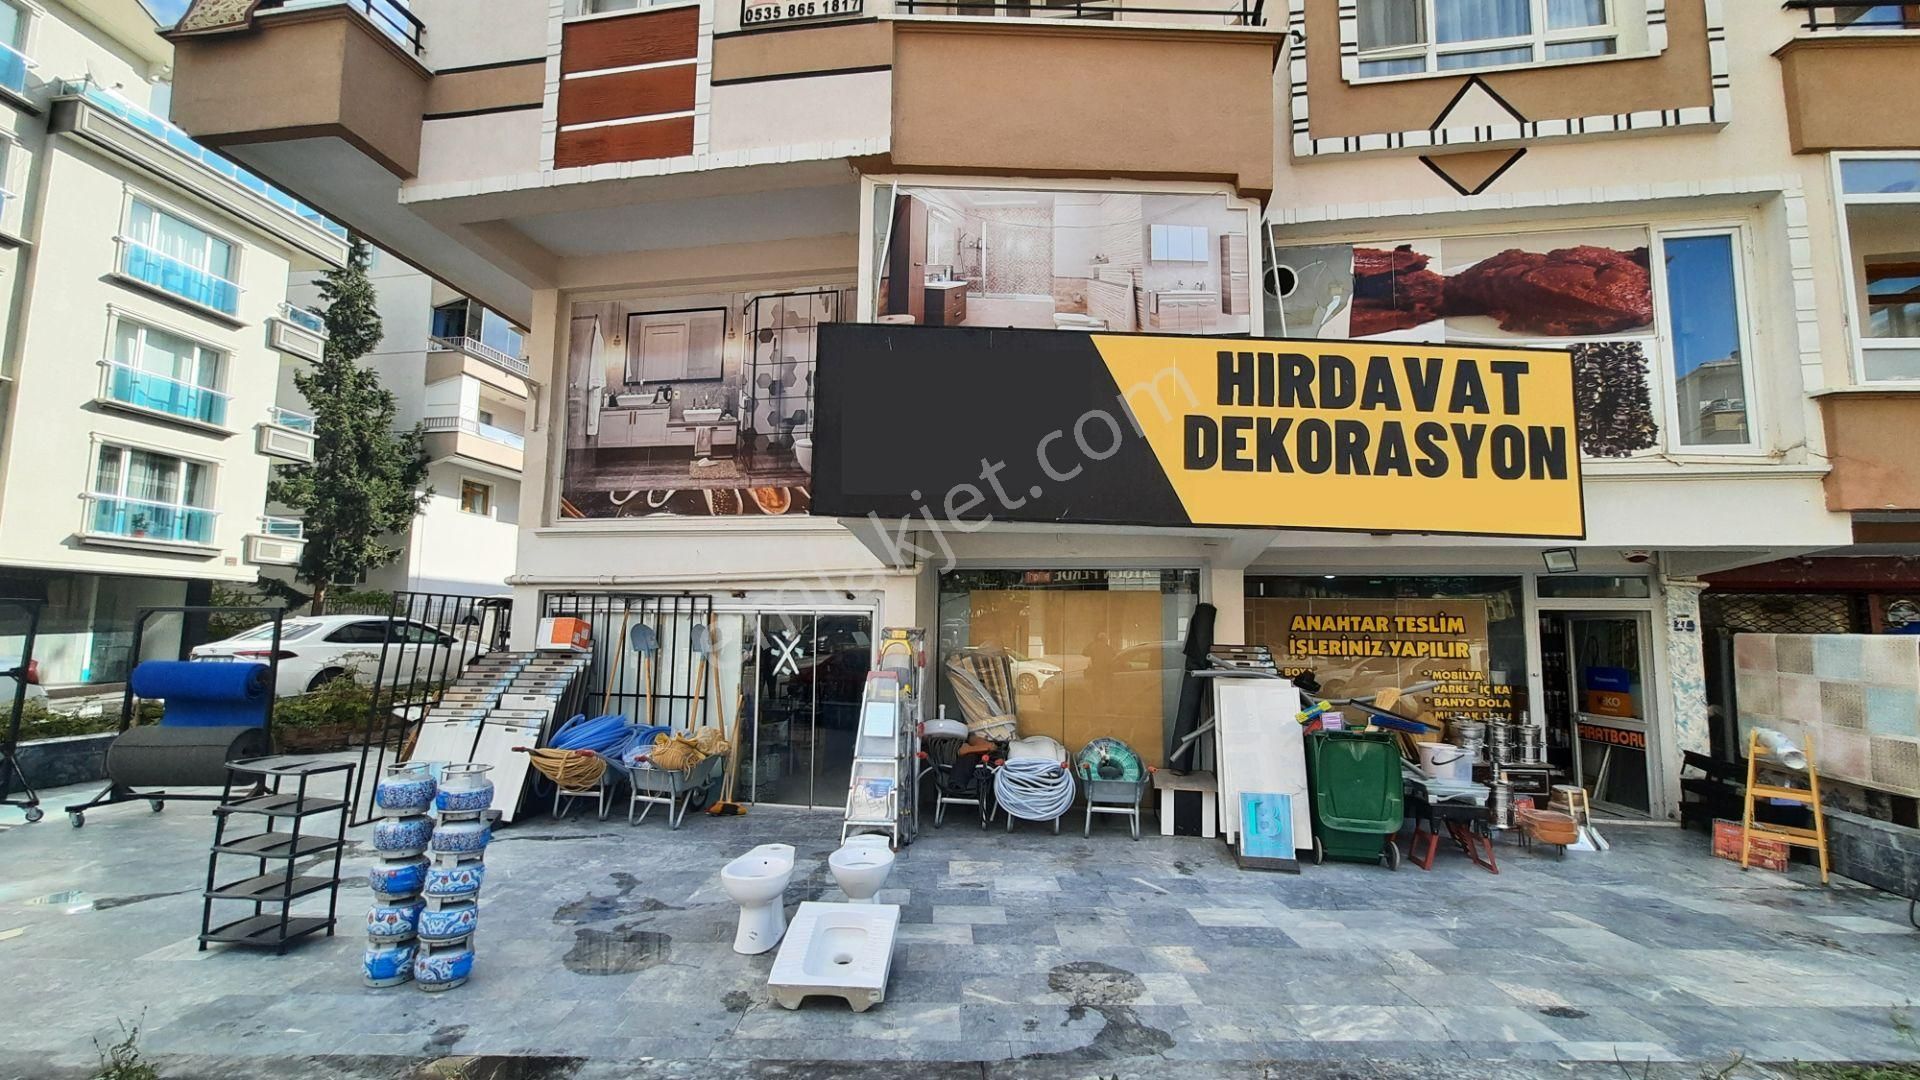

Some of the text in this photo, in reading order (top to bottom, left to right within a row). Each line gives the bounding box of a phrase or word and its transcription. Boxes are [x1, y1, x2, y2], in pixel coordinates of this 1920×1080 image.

[745, 0, 858, 22] 0535 865 1817
[1217, 350, 1529, 415] HIRDAVAT
[1183, 414, 1568, 480] DEKORASYON
[1291, 612, 1466, 633] ANAHTAR TESLİM
[1290, 635, 1470, 658] İŞLERİNİZ YAPILIR
[1432, 669, 1483, 680] MOBİLYA
[1494, 685, 1512, 694] KA
[1434, 698, 1475, 708] BANYO
